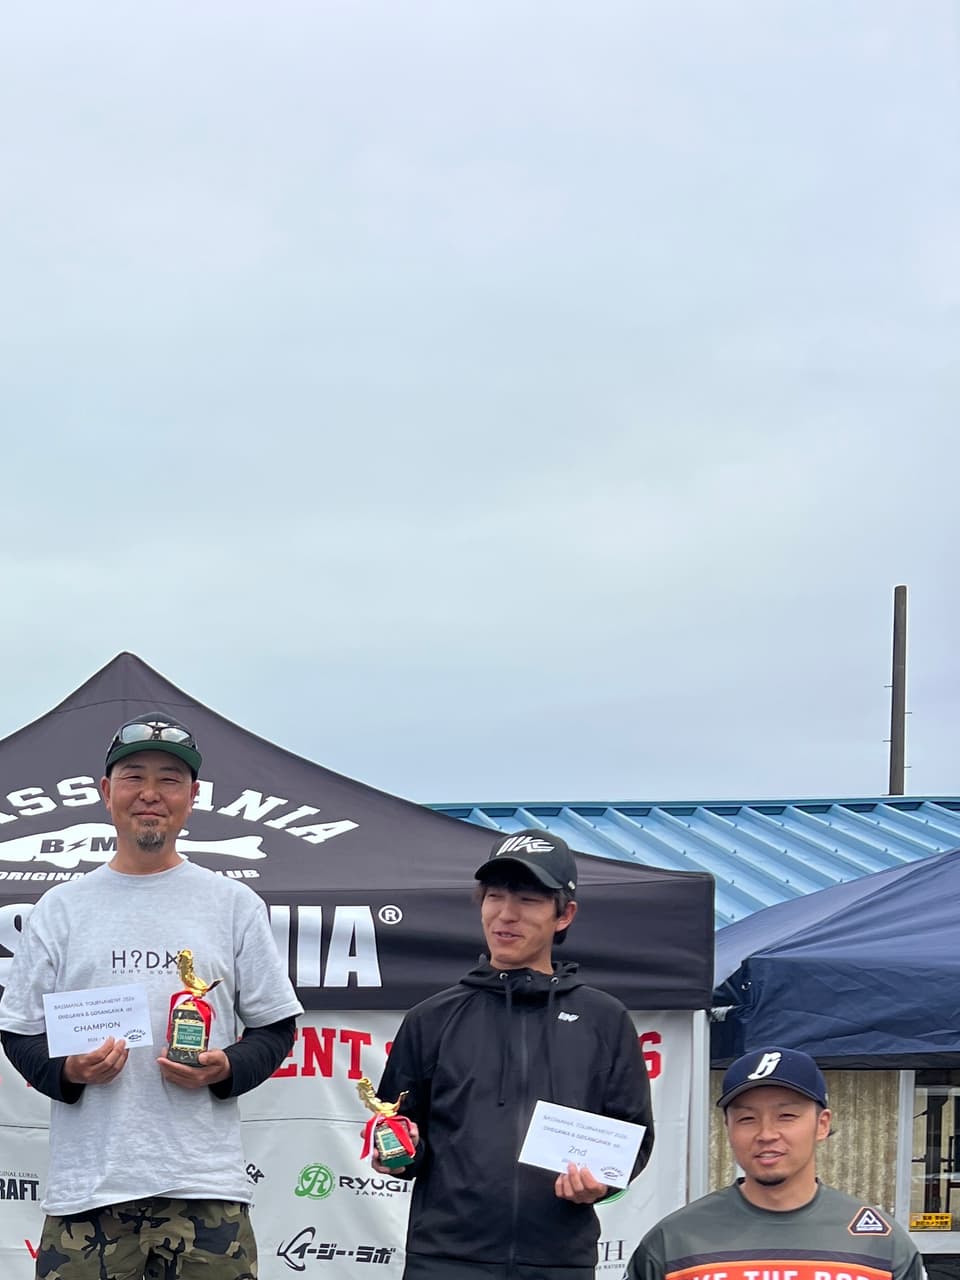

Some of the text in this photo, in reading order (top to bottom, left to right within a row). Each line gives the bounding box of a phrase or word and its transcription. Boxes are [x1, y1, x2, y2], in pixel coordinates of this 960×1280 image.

[73, 1021, 121, 1033] CHAMPION
[567, 1145, 588, 1157] 2nd
[339, 1175, 408, 1193] RYUGI
[354, 1190, 393, 1198] JAPAN
